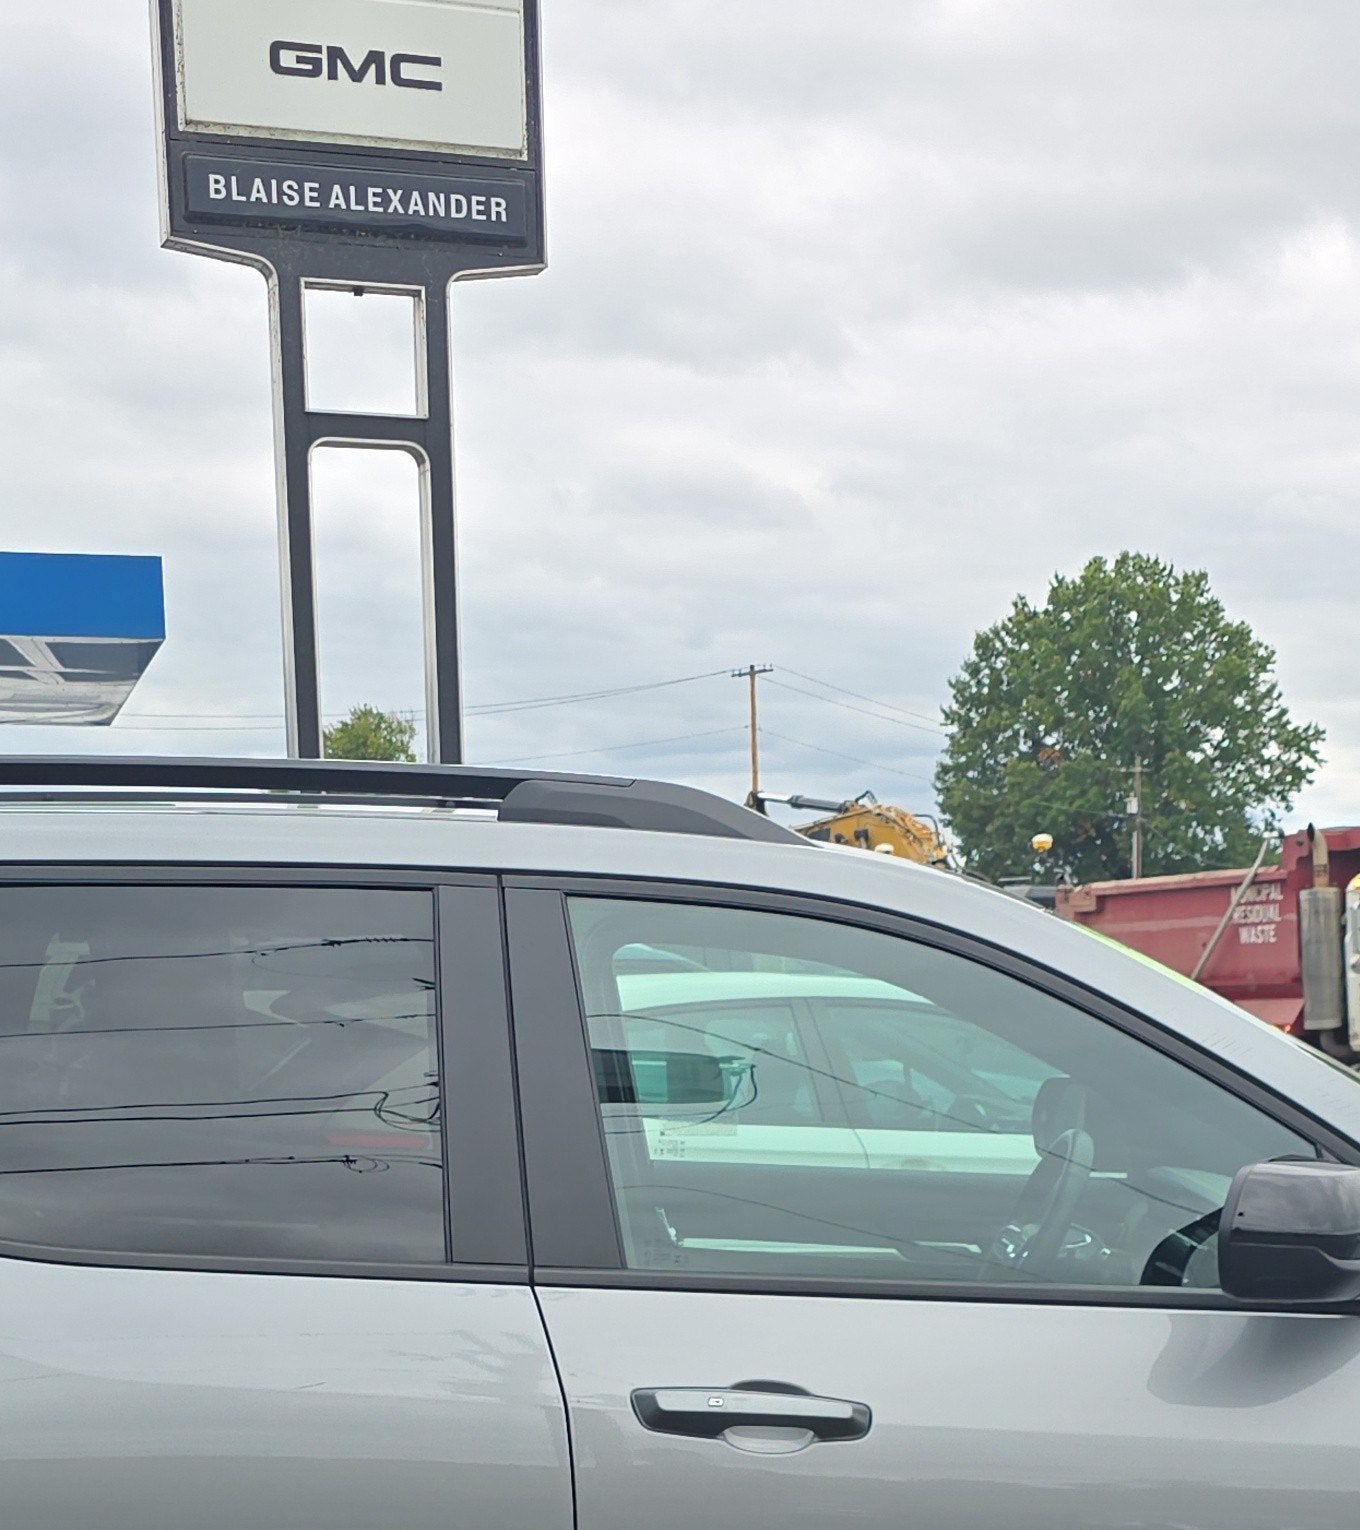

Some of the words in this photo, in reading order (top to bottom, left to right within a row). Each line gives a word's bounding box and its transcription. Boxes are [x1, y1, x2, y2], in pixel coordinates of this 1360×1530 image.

[269, 40, 443, 91] GMC
[208, 173, 321, 207] BLAISE
[328, 184, 508, 222] ALEXANDER
[1238, 924, 1278, 944] WASTE
